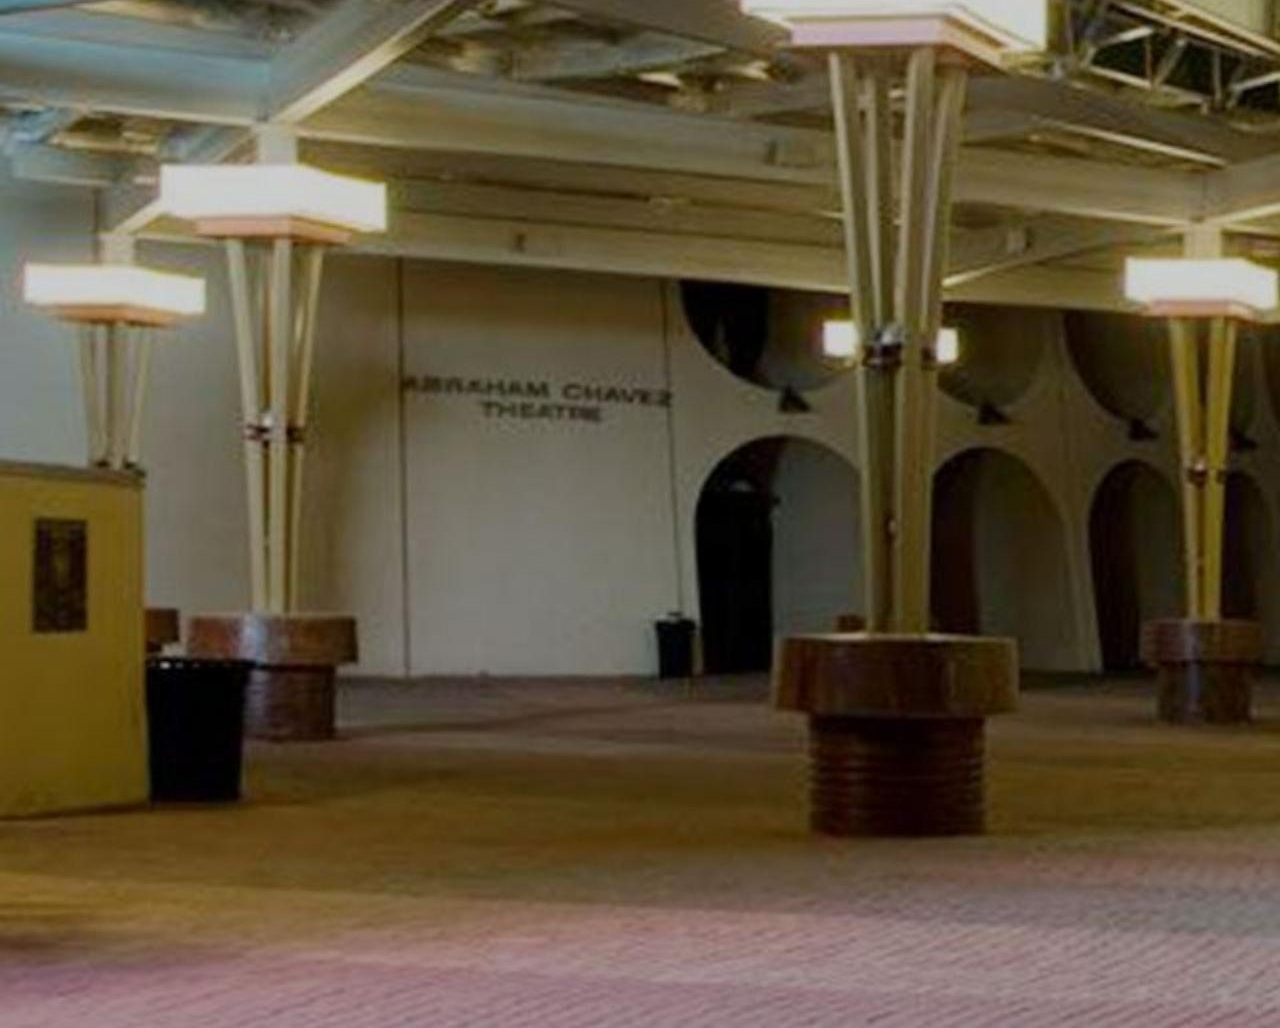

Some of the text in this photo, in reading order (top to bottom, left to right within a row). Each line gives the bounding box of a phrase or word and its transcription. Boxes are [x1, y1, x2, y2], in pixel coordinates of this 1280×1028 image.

[400, 376, 673, 408] ABRAHAM CHAVEZ
[481, 401, 603, 423] THEATRE
